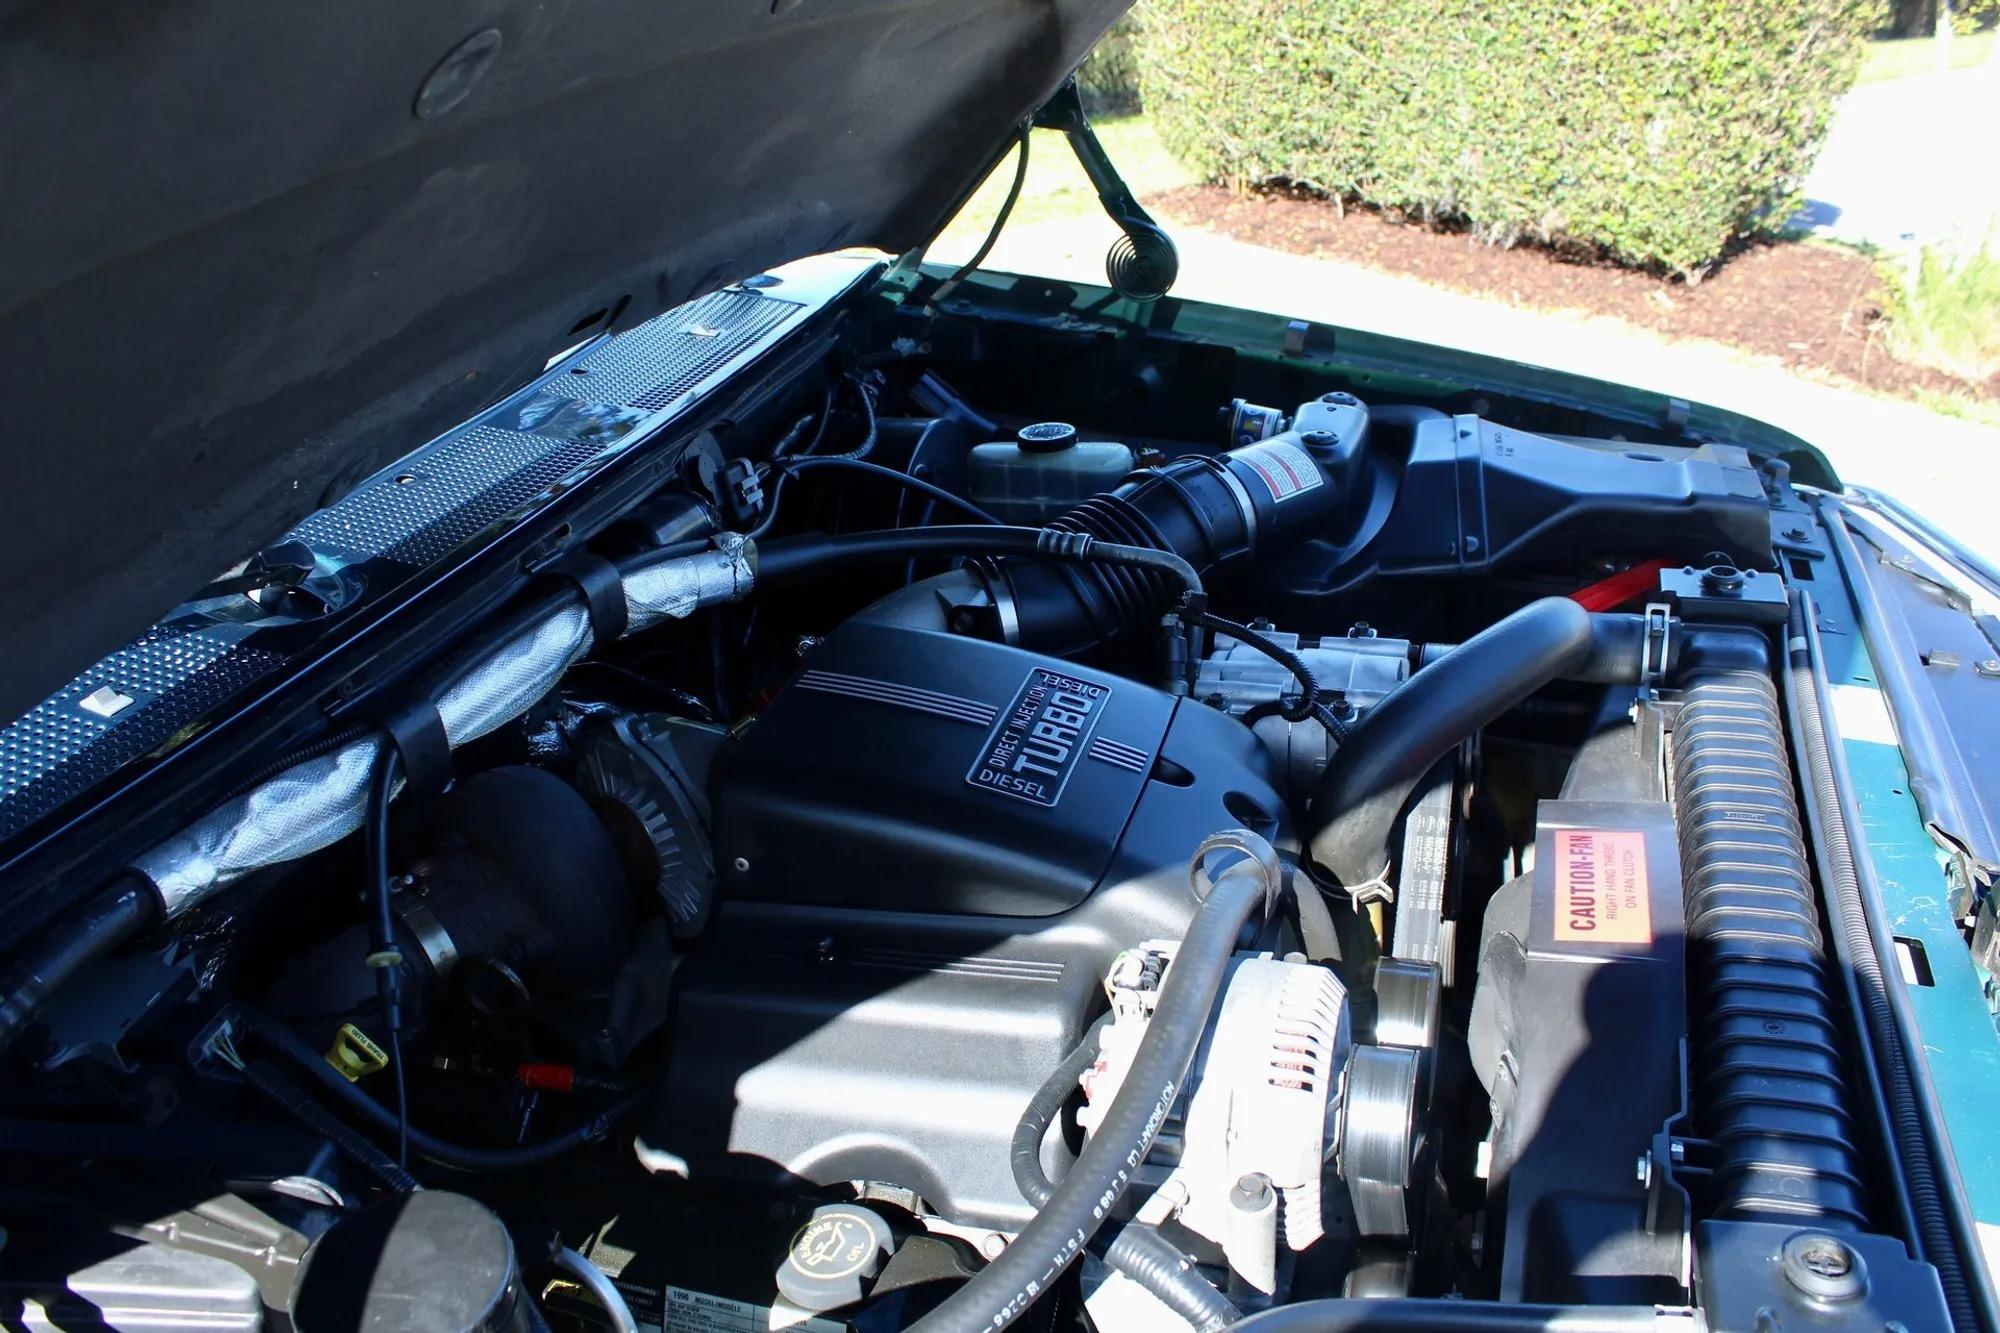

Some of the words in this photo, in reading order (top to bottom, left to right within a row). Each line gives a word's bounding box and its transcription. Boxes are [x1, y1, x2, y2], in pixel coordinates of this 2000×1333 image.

[1040, 672, 1101, 698] DIESEL
[989, 730, 1022, 769] DIRECT
[1012, 684, 1048, 730] INJECTION
[1012, 691, 1094, 777] TURBO
[979, 768, 1047, 799] DIESEL
[1604, 869, 1617, 891] HAND
[1624, 880, 1636, 893] FAN
[1606, 894, 1618, 920] RIGHT
[1625, 896, 1637, 909] ON
[1138, 1080, 1174, 1152] MOTORCRAFT
[846, 1242, 865, 1261] OIL
